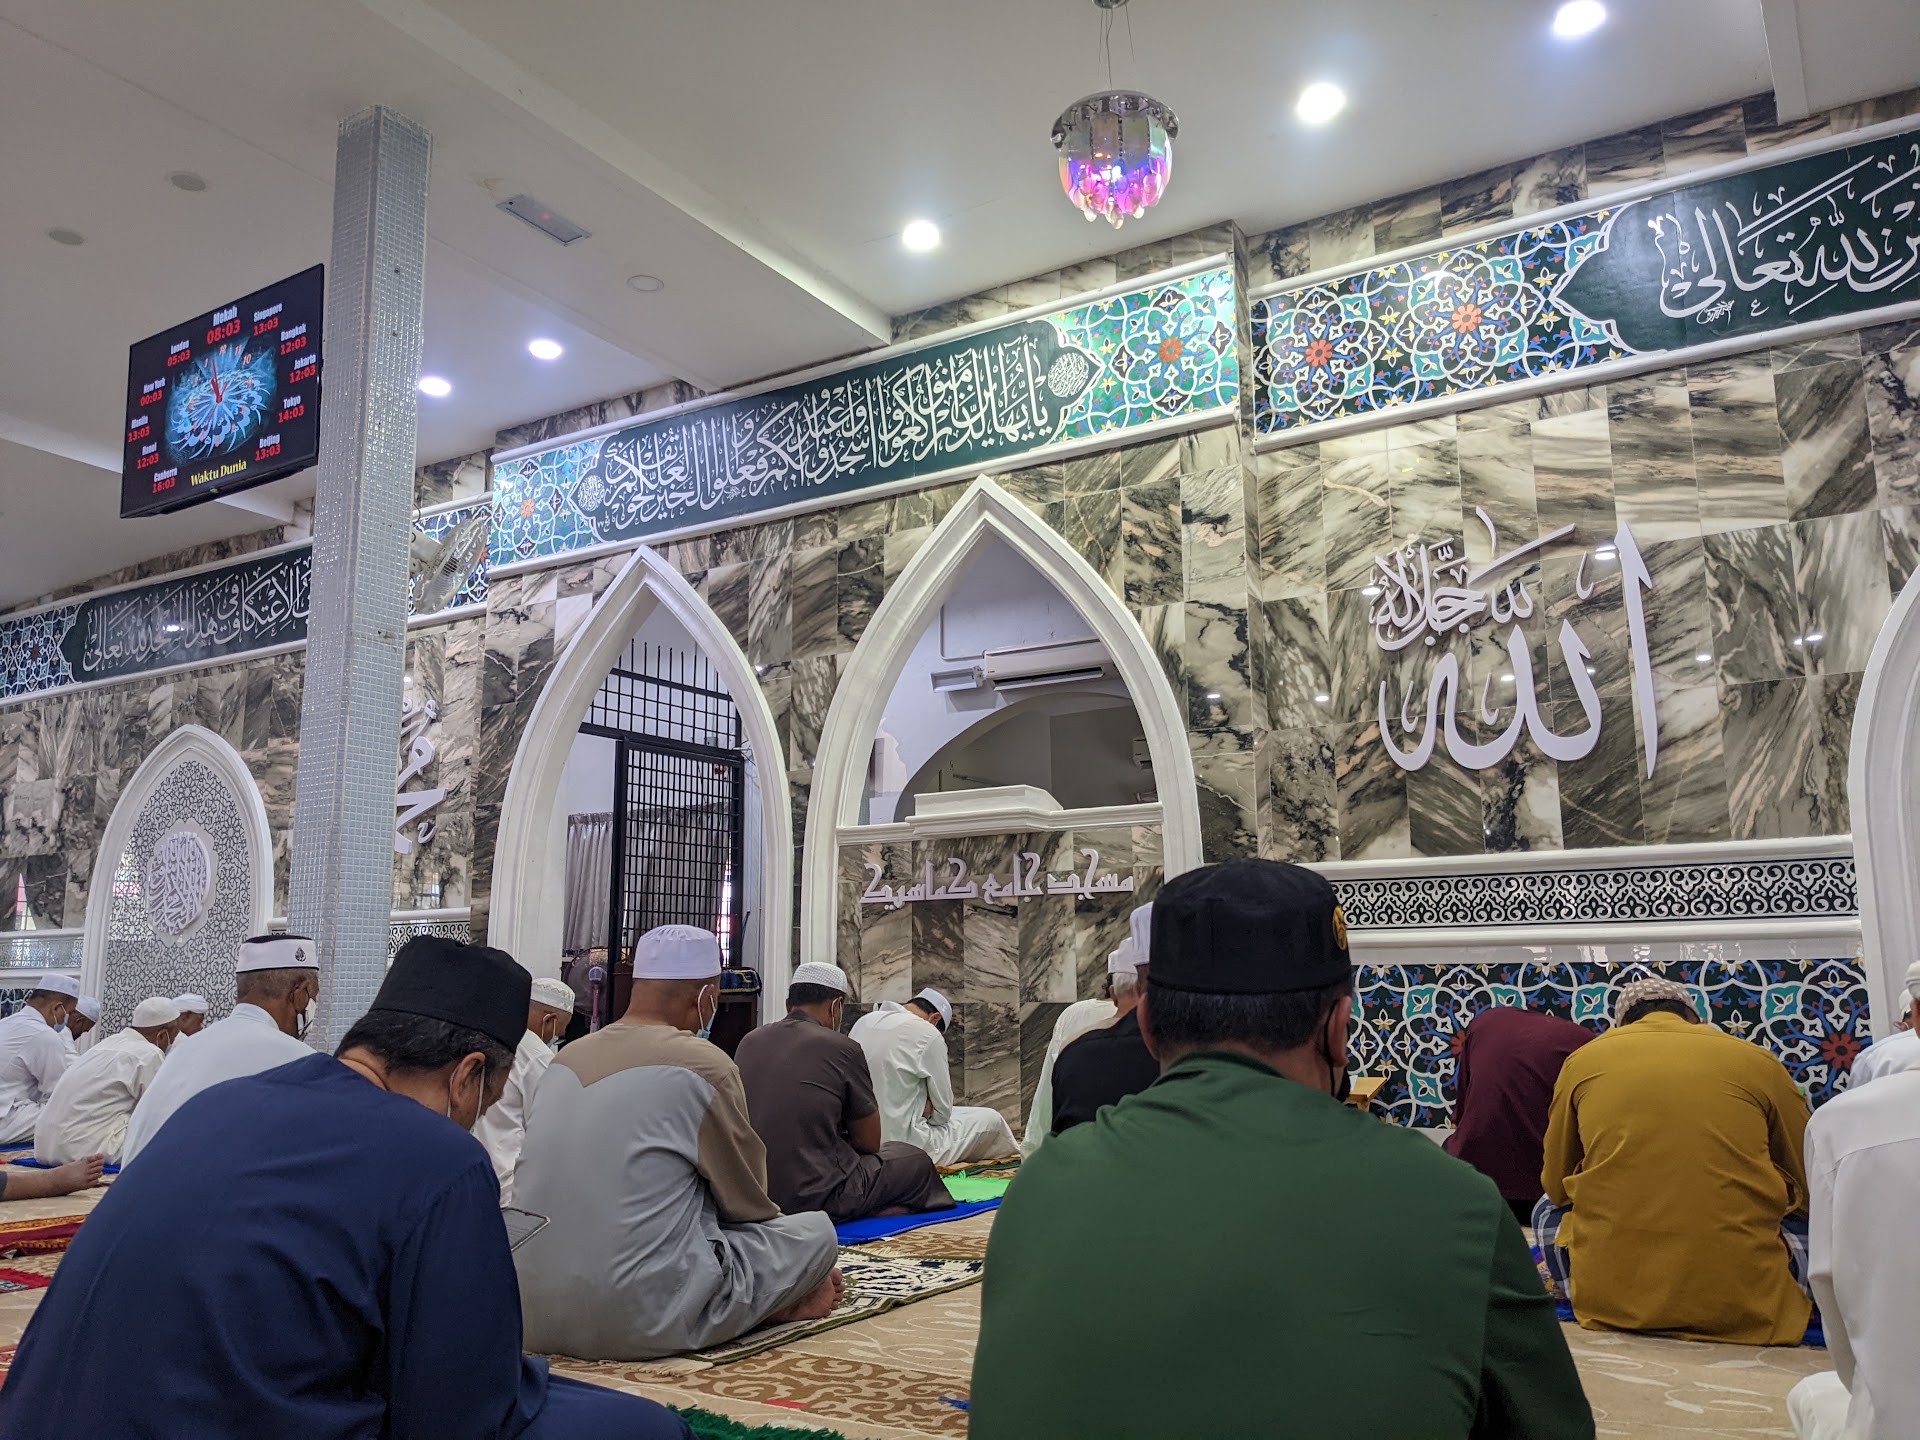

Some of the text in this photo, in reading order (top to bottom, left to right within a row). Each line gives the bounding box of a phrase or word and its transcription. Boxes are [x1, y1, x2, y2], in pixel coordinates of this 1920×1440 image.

[213, 305, 238, 326] Mekah
[253, 303, 283, 322] Singapore
[206, 318, 241, 344] 08:03
[253, 317, 279, 336] 13:03
[280, 323, 307, 341] Bangkok
[170, 339, 190, 355] London
[280, 336, 307, 355] 12:03
[167, 349, 191, 367] 05:03
[294, 354, 317, 370] Jakarta
[289, 365, 317, 383] 12:03
[140, 389, 163, 407] 00:03
[283, 395, 301, 409] Tokyo
[278, 405, 304, 423] 14:03
[259, 433, 280, 449] Beijing
[137, 453, 159, 469] 12:03
[255, 444, 281, 461] 13:03
[190, 459, 247, 487] Waktu Dunia
[152, 477, 176, 494] 16:03
[981, 852, 1043, 905] جامع
[1047, 849, 1134, 900] مسجد
